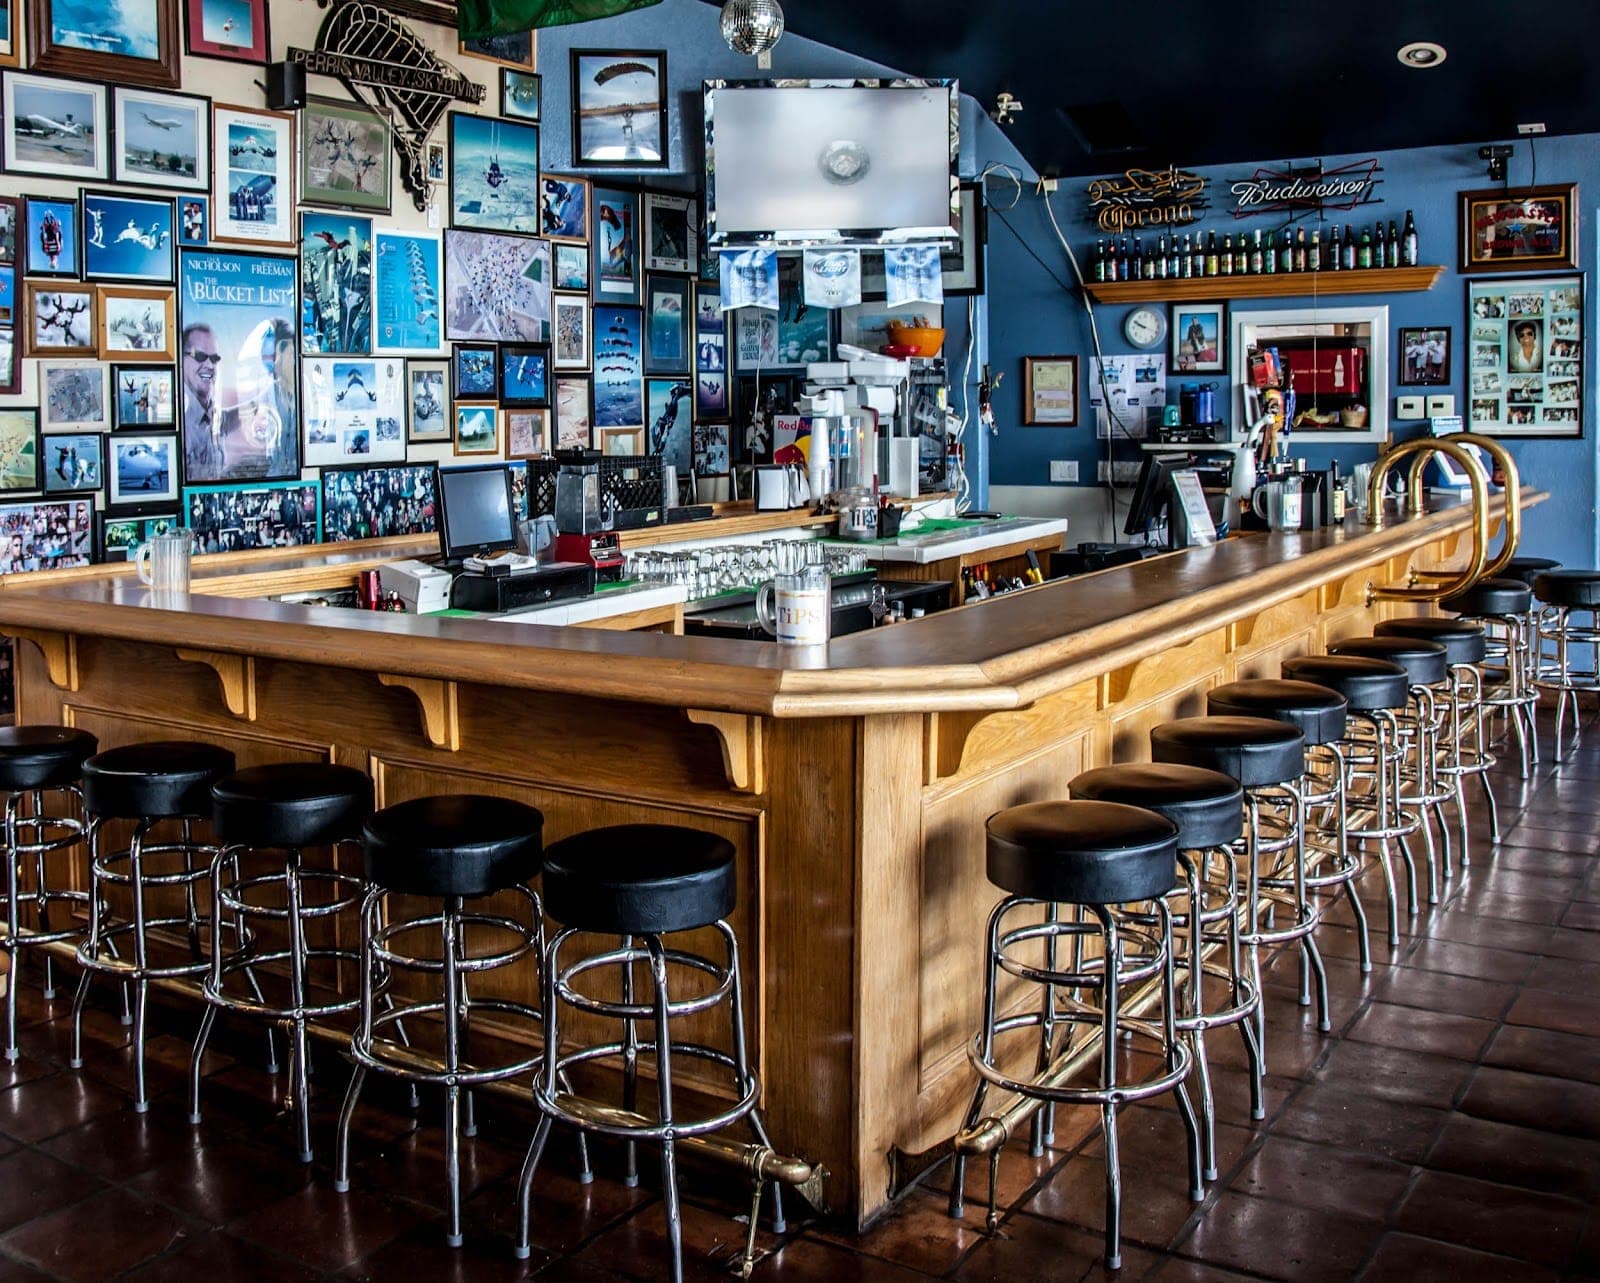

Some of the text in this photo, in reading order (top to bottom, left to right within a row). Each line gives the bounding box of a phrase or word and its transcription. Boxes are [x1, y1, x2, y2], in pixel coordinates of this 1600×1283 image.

[294, 51, 487, 101] PERRIS VALLEY SKYDIVING
[1231, 178, 1372, 206] Budweiser
[1099, 204, 1193, 234] Corona
[188, 259, 241, 272] NICHOLSON
[251, 263, 292, 276] FREEMAN
[203, 276, 217, 285] THE
[194, 281, 288, 304] BUCKET LIST
[777, 420, 797, 430] Red
